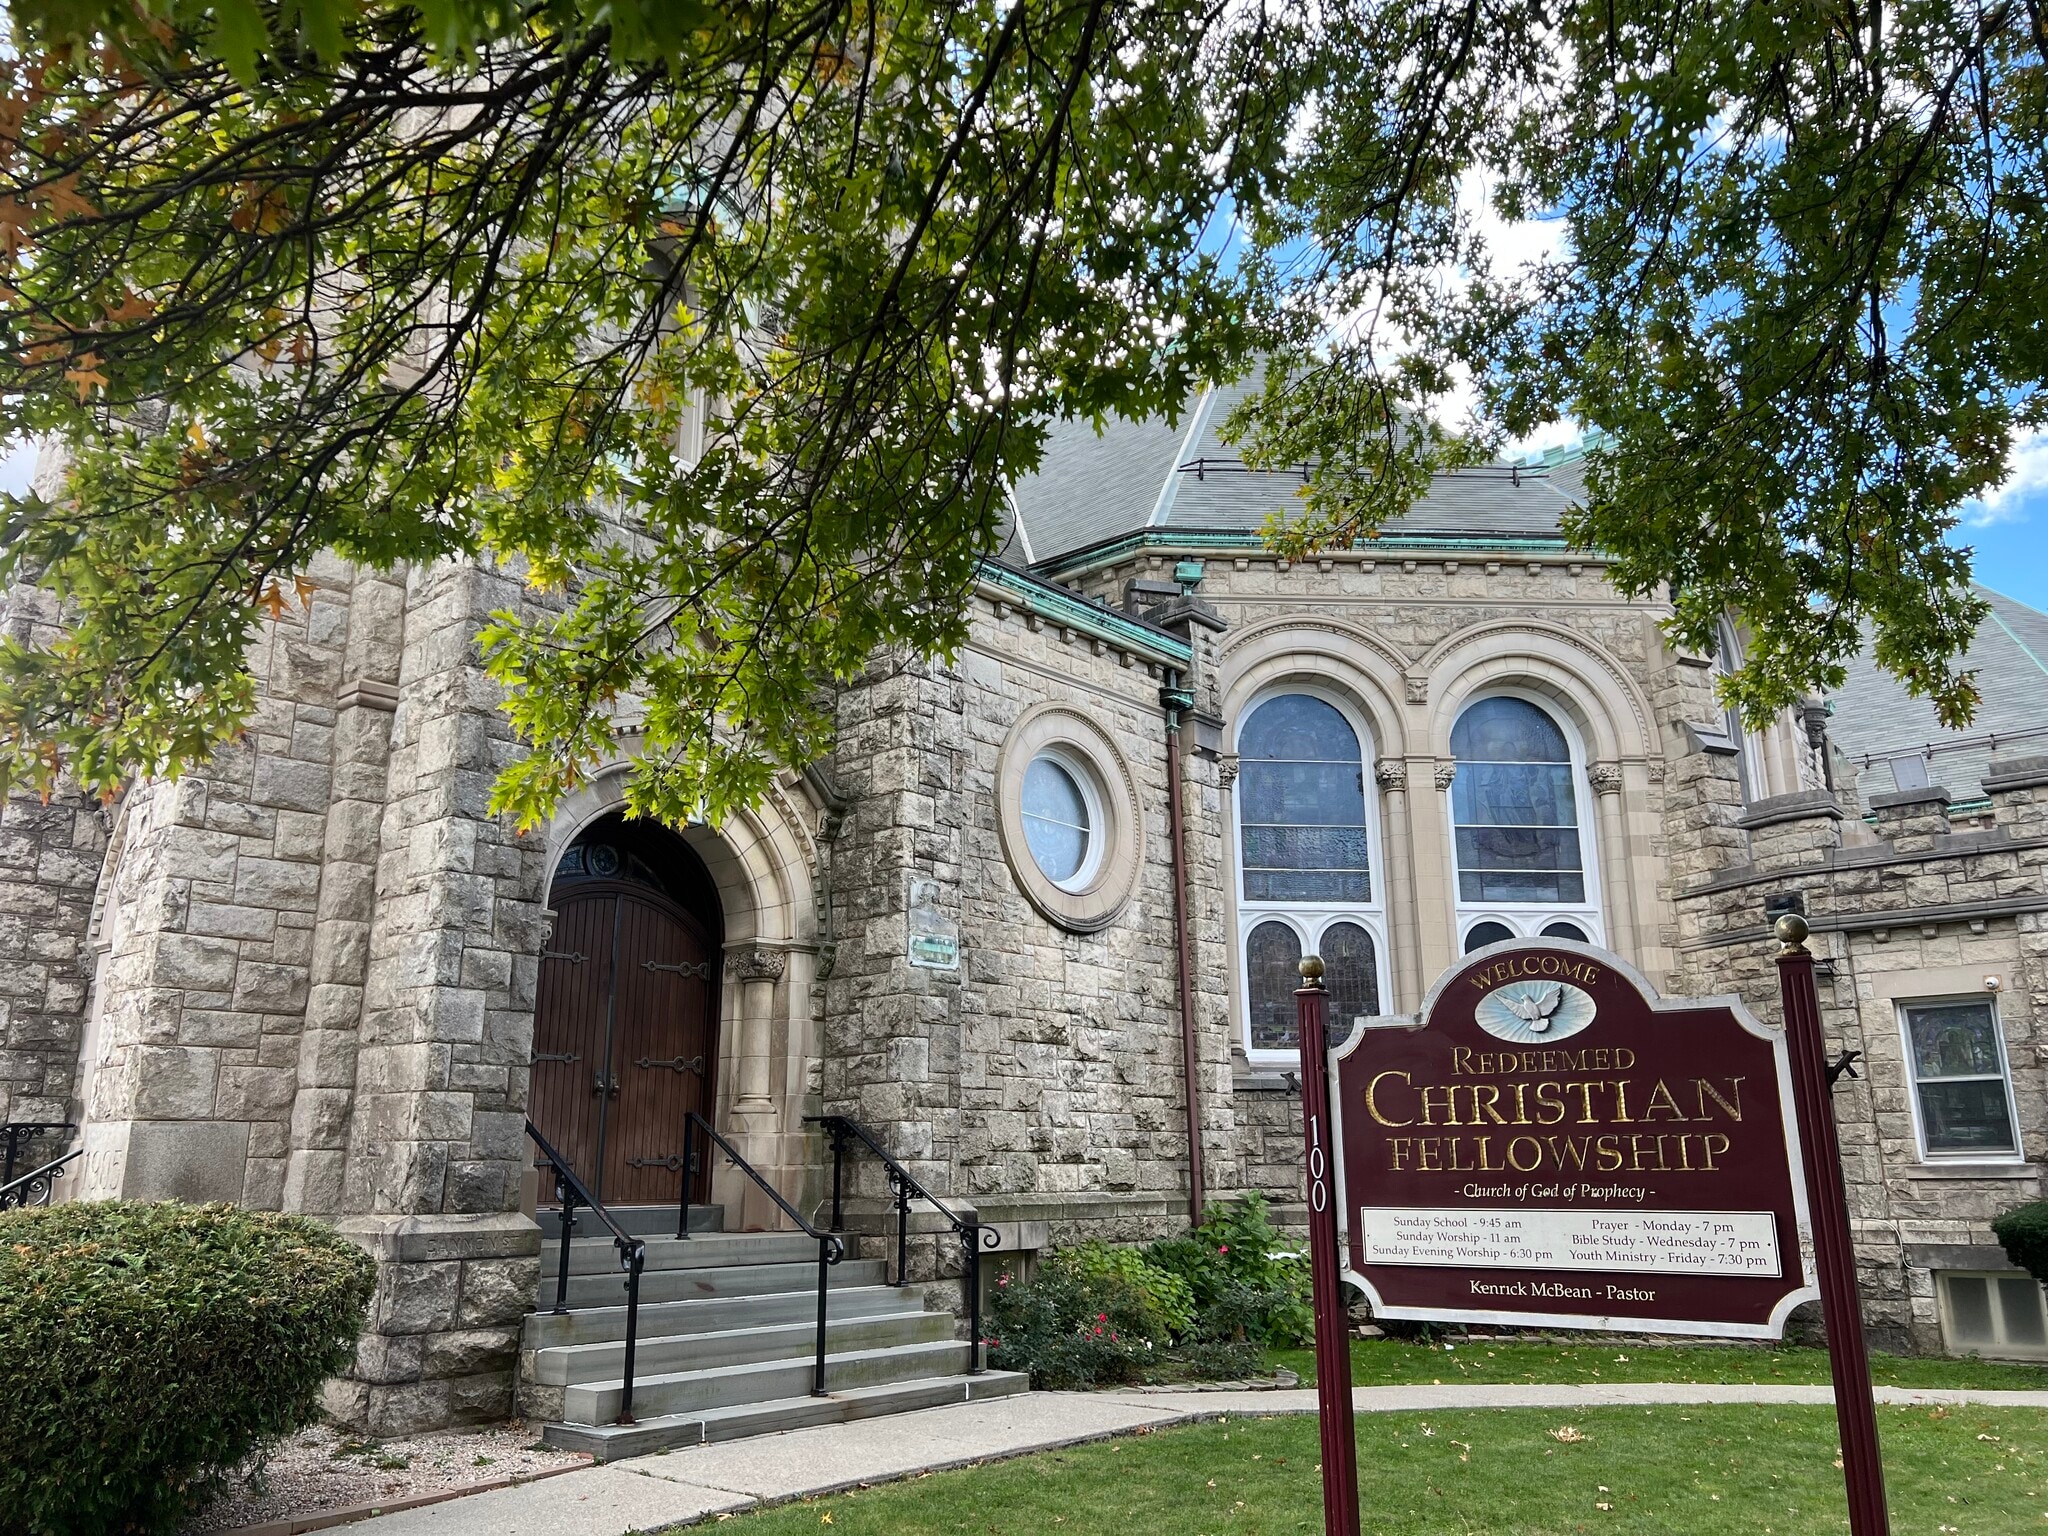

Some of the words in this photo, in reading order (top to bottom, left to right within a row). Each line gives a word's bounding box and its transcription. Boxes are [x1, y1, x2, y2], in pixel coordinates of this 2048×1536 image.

[1467, 956, 1600, 990] WELCOME
[1450, 1046, 1635, 1075] REDEEMED
[1365, 1070, 1746, 1129] CHRISTIAN
[1386, 1131, 1730, 1172] FELLOWSHIP
[81, 1150, 122, 1190] 1905
[1310, 1114, 1326, 1212] 100
[1463, 1183, 1511, 1198] Church
[1514, 1183, 1529, 1201] of
[1531, 1183, 1559, 1198] God
[1563, 1183, 1578, 1201] of
[1580, 1183, 1645, 1202] Prophecy
[1393, 1217, 1431, 1229] Sunday
[1433, 1217, 1468, 1228] School
[1479, 1218, 1501, 1228] 9:45
[1505, 1220, 1522, 1229] am
[1591, 1219, 1629, 1232] Prayer
[1643, 1220, 1692, 1233] Monday
[1702, 1221, 1710, 1232] 7
[1713, 1224, 1735, 1236] pm
[1396, 1231, 1434, 1244] Sunday
[1436, 1232, 1480, 1245] Worship
[1490, 1233, 1501, 1243] 11
[1503, 1235, 1521, 1244] am
[1571, 1235, 1600, 1245] Bible
[1602, 1235, 1636, 1248] Study
[1646, 1236, 1717, 1250] Wednesday
[1727, 1238, 1736, 1249] 7
[1739, 1240, 1761, 1252] pm
[1372, 1245, 1410, 1257] Sunday
[1412, 1246, 1454, 1259] Evening
[1456, 1247, 1501, 1260] Worship
[1509, 1248, 1532, 1259] 6:30
[1535, 1251, 1553, 1262] pm
[1569, 1250, 1603, 1261] Youth
[1605, 1251, 1657, 1265] Ministry
[1668, 1252, 1707, 1267] Friday
[1717, 1254, 1743, 1265] 7:30
[1746, 1256, 1768, 1269] pm
[1469, 1280, 1527, 1296] Kenrick
[1530, 1282, 1592, 1299] McBean
[1606, 1285, 1656, 1301] Pastor
